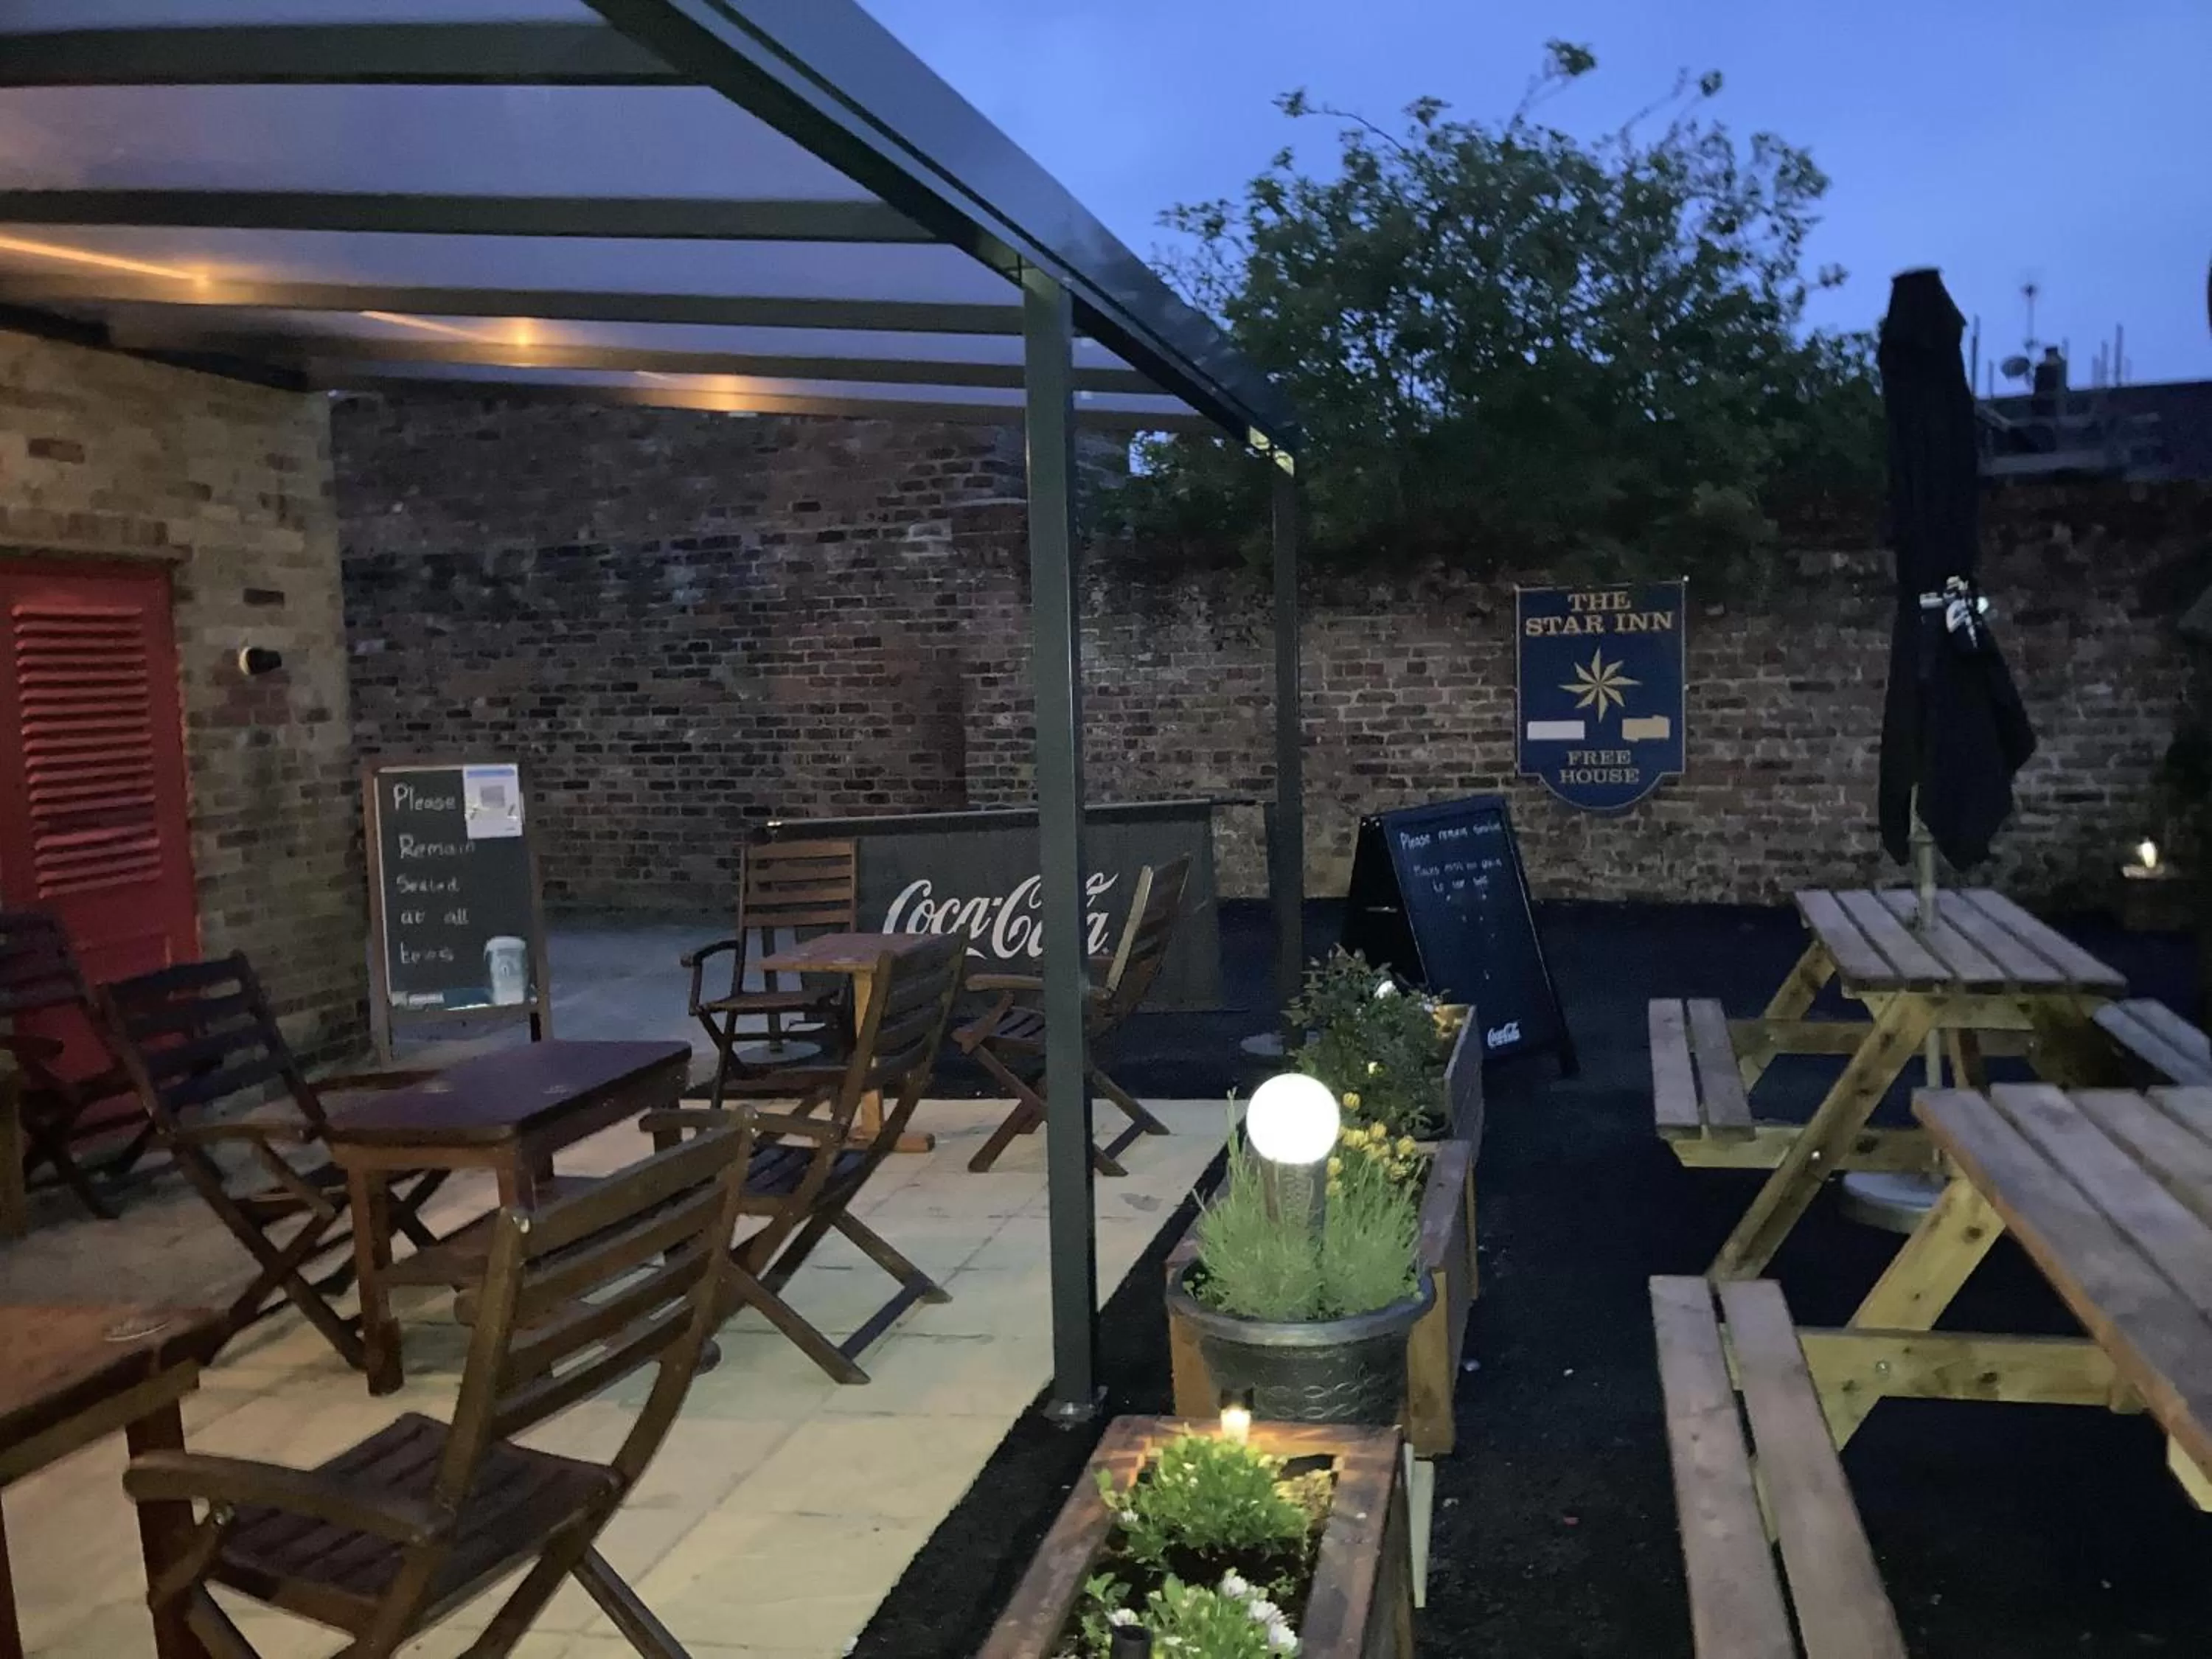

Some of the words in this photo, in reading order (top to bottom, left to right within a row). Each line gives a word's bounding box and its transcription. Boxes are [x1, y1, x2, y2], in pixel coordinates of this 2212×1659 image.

[1568, 591, 1632, 612] THE
[1526, 611, 1605, 636] STAR
[1614, 611, 1674, 633] INN
[1567, 749, 1632, 765] FREE
[1559, 768, 1641, 785] HOUSE
[393, 782, 456, 812] Please
[399, 832, 476, 859] Remain
[883, 872, 1119, 959] Coca-Ca
